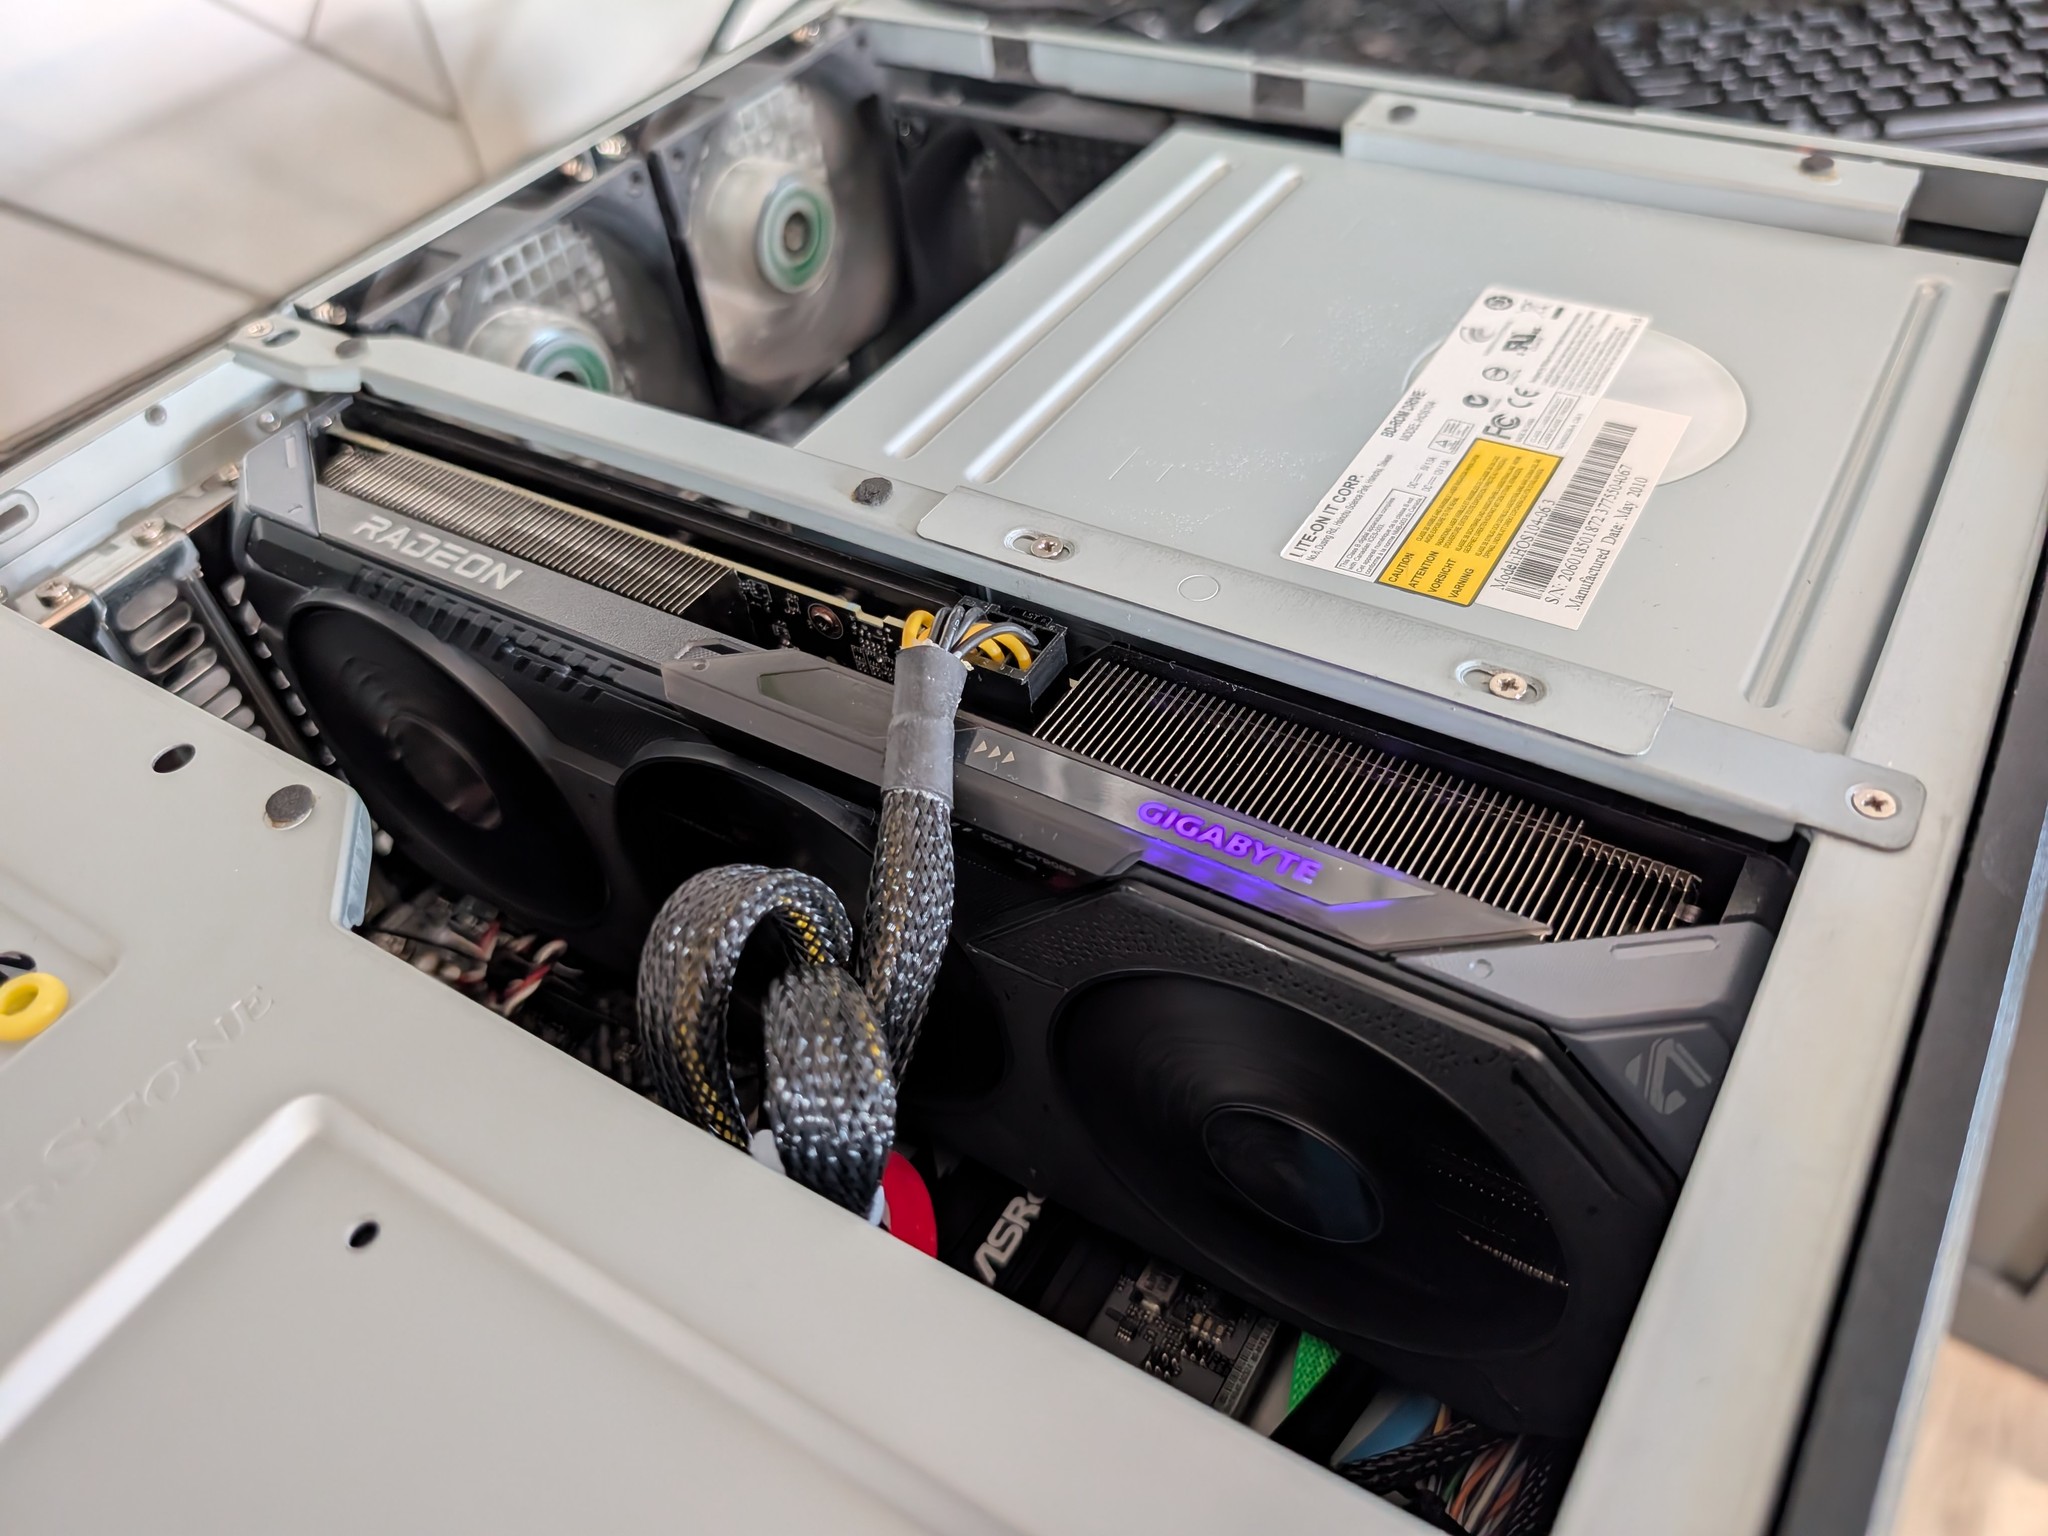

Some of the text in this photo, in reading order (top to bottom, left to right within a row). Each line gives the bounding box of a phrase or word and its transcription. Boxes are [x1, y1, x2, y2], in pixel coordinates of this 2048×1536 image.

[1330, 473, 1363, 503] CORP.
[1321, 503, 1340, 514] IT
[353, 514, 524, 590] RADEON
[1563, 476, 1649, 610] Manufactured Date: May 2010
[1387, 552, 1415, 582] CAUTION
[1407, 550, 1439, 588] ATTENTION
[1427, 558, 1457, 593] VORSICHT
[1448, 567, 1475, 599] VARNING
[1543, 582, 1568, 605] S/N:
[1137, 801, 1323, 885] GIGABYTE
